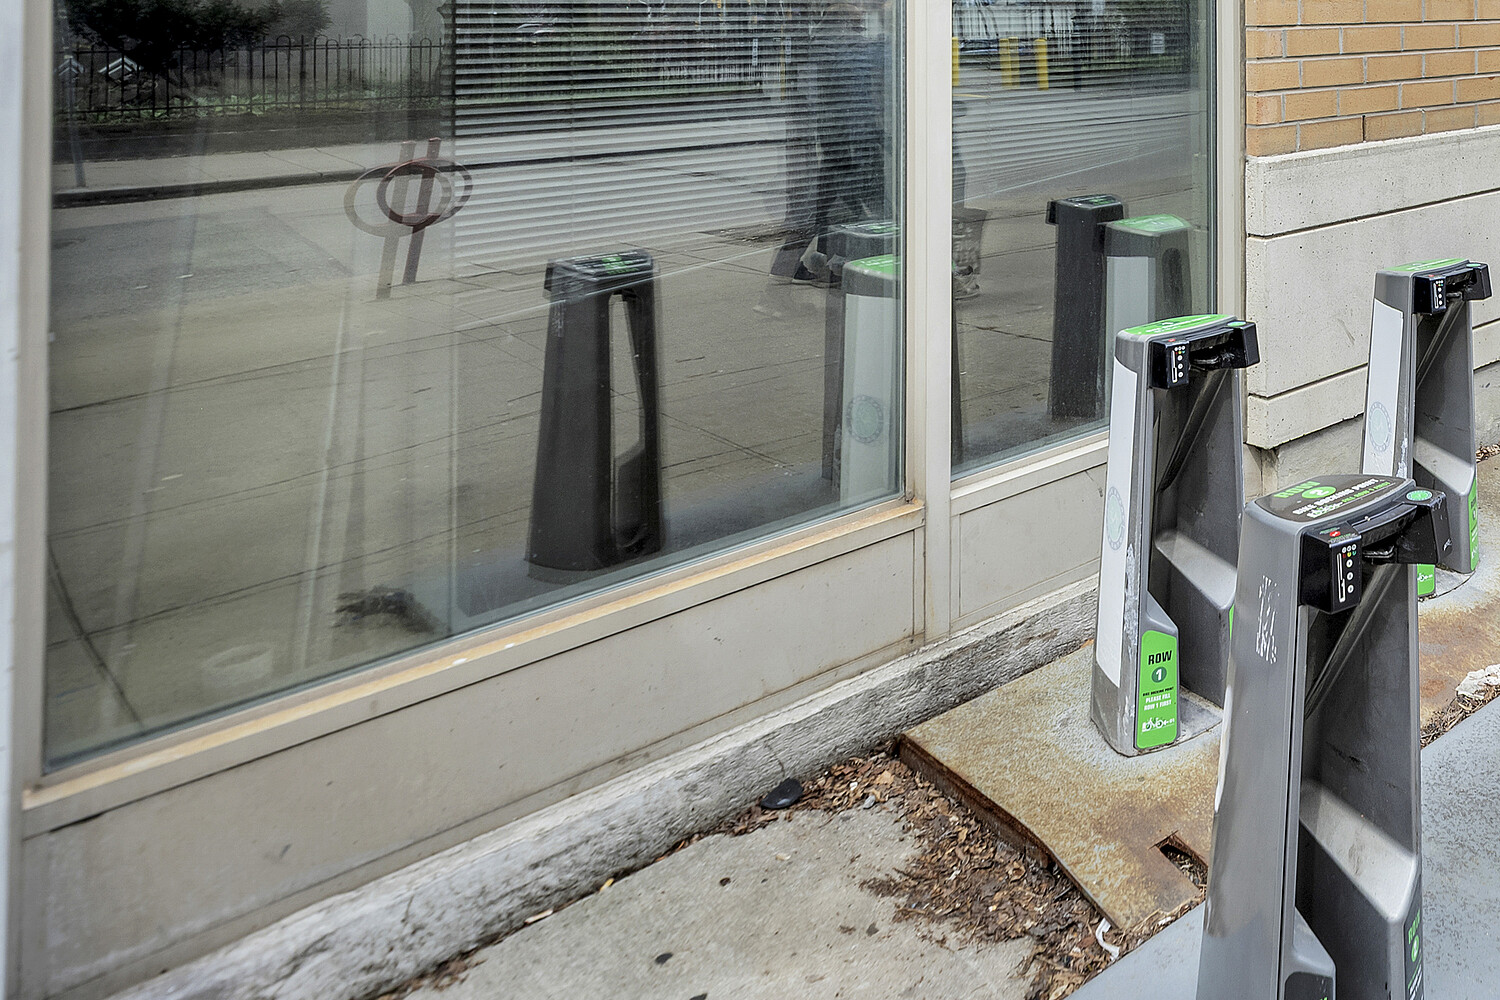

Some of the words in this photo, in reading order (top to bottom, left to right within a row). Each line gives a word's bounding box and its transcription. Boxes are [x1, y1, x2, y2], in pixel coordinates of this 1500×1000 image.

[1148, 650, 1172, 665] ROW
[1156, 669, 1162, 680] 1
[1146, 695, 1161, 703] PLEASE
